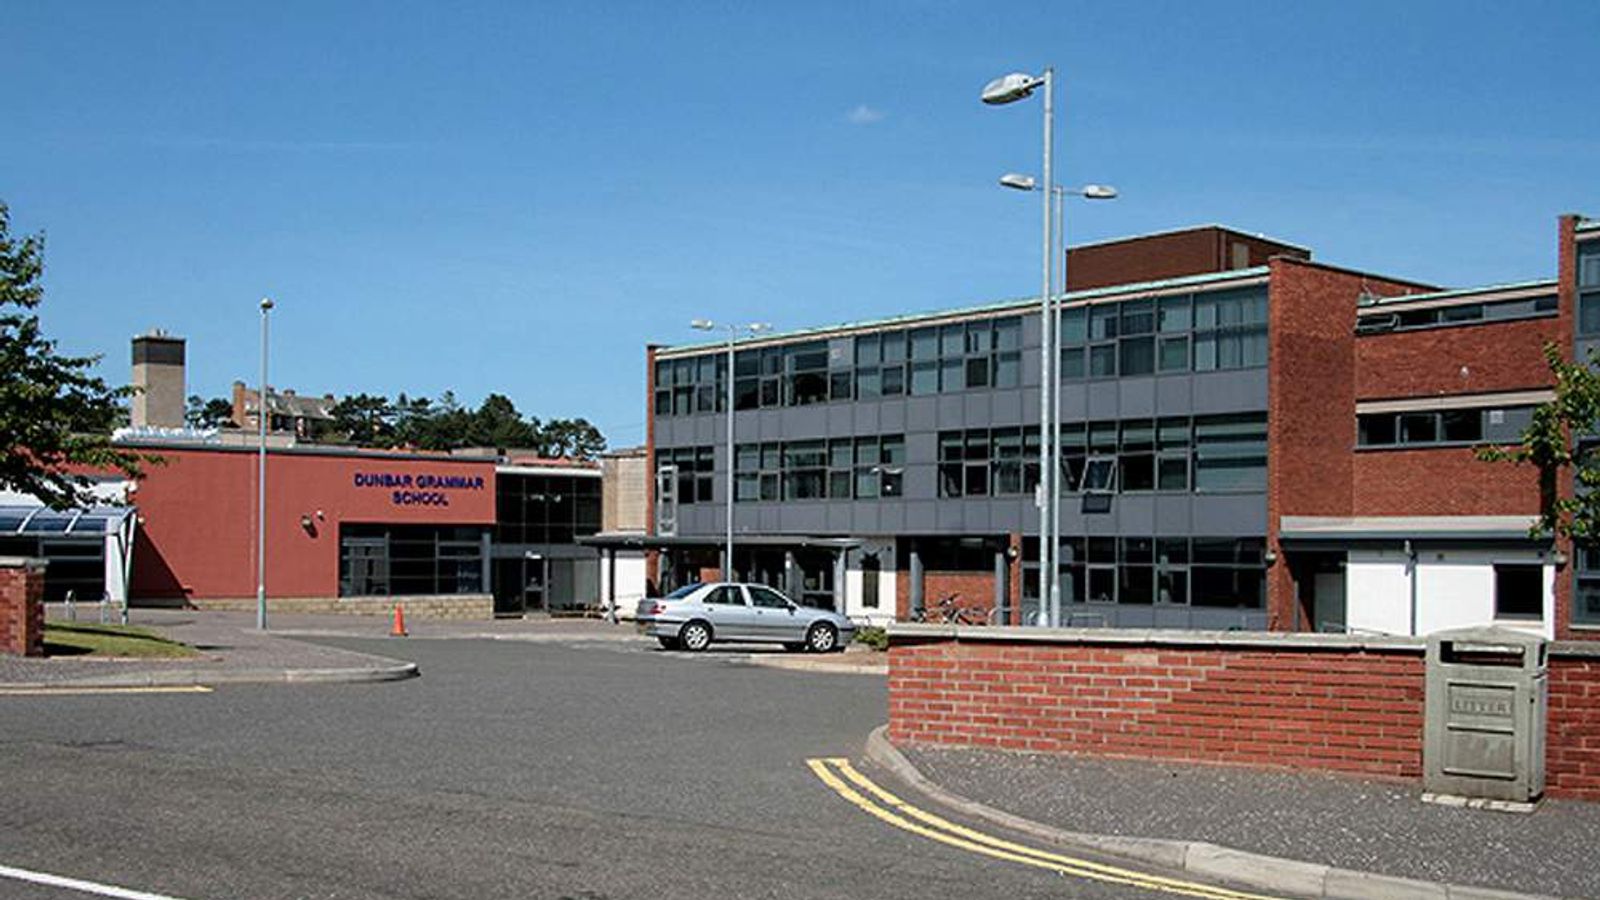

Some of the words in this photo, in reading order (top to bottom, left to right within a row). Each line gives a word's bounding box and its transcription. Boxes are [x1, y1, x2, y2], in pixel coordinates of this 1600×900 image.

[354, 473, 412, 488] DUNBAR
[416, 475, 484, 490] GRAMMAR
[393, 491, 449, 506] SCHOOL
